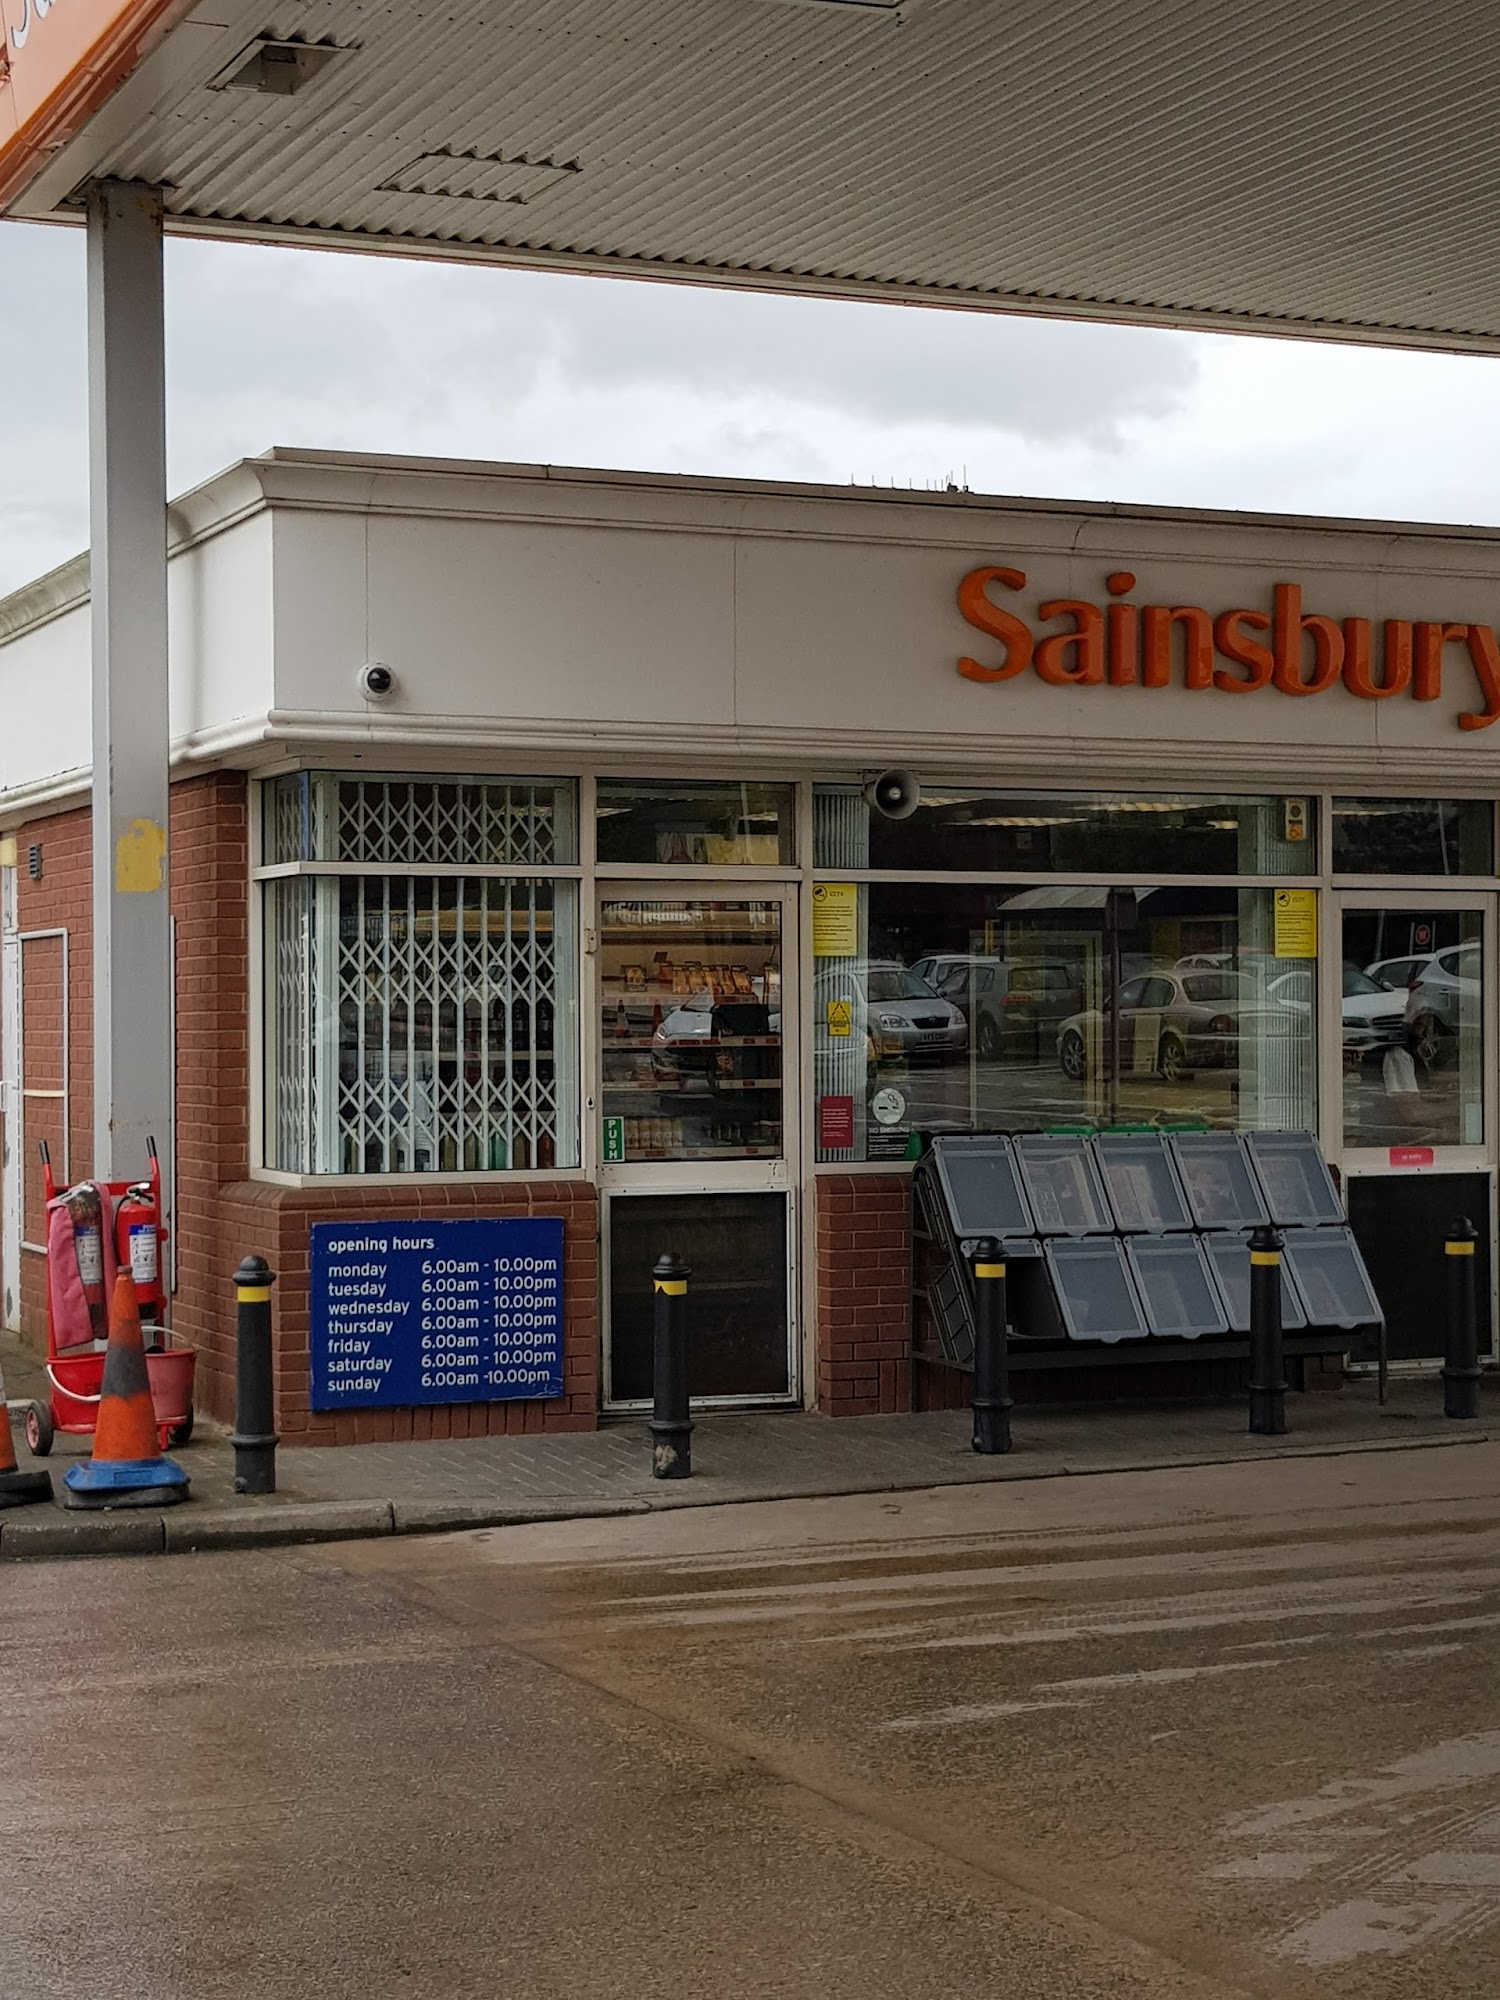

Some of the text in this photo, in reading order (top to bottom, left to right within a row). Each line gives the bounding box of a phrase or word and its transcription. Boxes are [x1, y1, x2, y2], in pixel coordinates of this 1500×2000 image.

[608, 1119, 618, 1159] PUSH
[328, 1236, 435, 1255] opening hours
[328, 1262, 387, 1279] monday
[421, 1259, 479, 1275] 6.00am
[493, 1257, 557, 1273] 10.00pm
[328, 1281, 387, 1298] tuesday
[421, 1278, 479, 1293] 6.00am
[493, 1275, 557, 1292] 10.00pm
[328, 1299, 410, 1316] wednesday
[421, 1296, 479, 1312] 6.00am
[493, 1294, 557, 1311] 10.00pm
[328, 1318, 394, 1335] thursday
[421, 1315, 479, 1330] 6.00am
[493, 1312, 557, 1329] 10.00pm
[328, 1338, 371, 1355] friday
[421, 1334, 479, 1349] 6.00am
[493, 1331, 556, 1347] 10.00pm
[328, 1356, 393, 1373] saturday
[421, 1352, 479, 1368] 6.00am
[493, 1349, 556, 1366] 10.00pm
[328, 1376, 381, 1392] sunday
[421, 1371, 479, 1387] 6.00am
